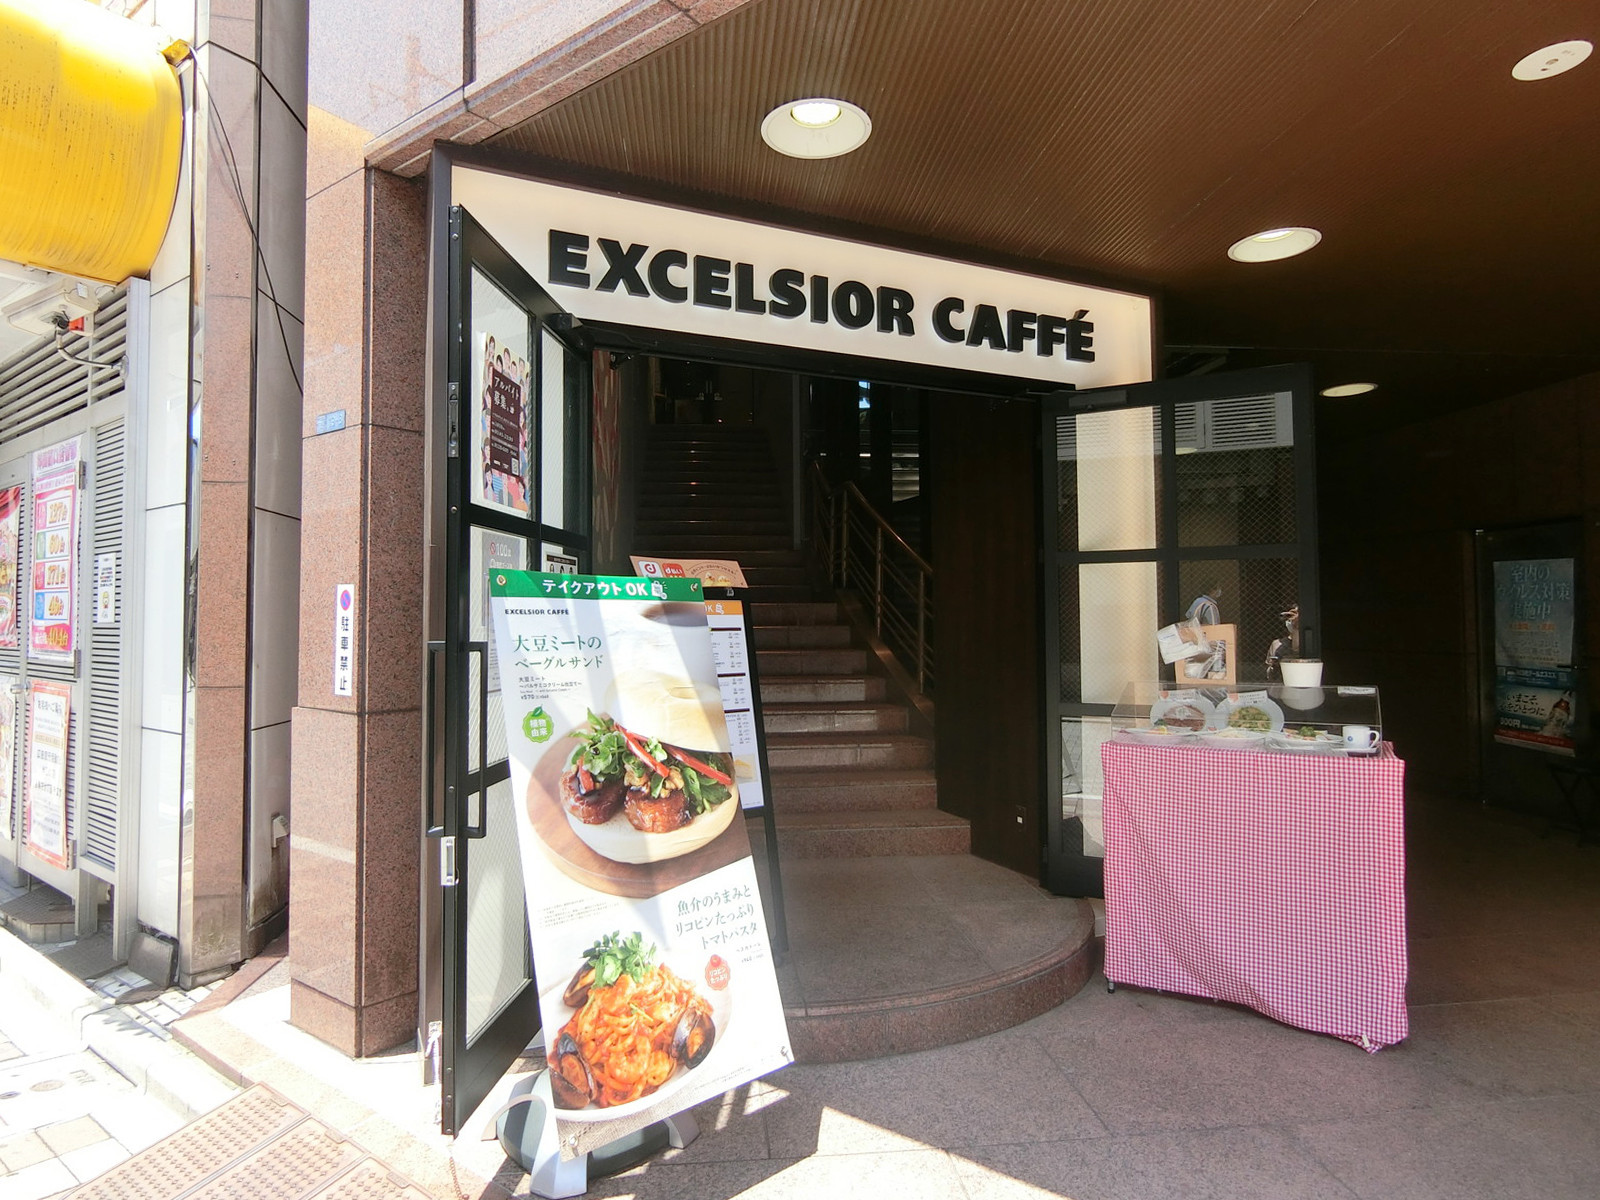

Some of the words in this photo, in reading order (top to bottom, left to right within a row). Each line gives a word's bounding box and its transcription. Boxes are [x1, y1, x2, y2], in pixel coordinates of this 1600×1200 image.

[549, 229, 915, 336] EXCELSIOR
[932, 293, 1094, 362] CAFFÉ
[542, 579, 622, 596] テイクアウト
[625, 583, 648, 596] OK
[340, 616, 349, 691] 駐車禁止
[513, 634, 602, 653] 大豆ミートの
[515, 655, 604, 670] ベーグルサンド
[678, 885, 752, 916] 魚介のうまみと
